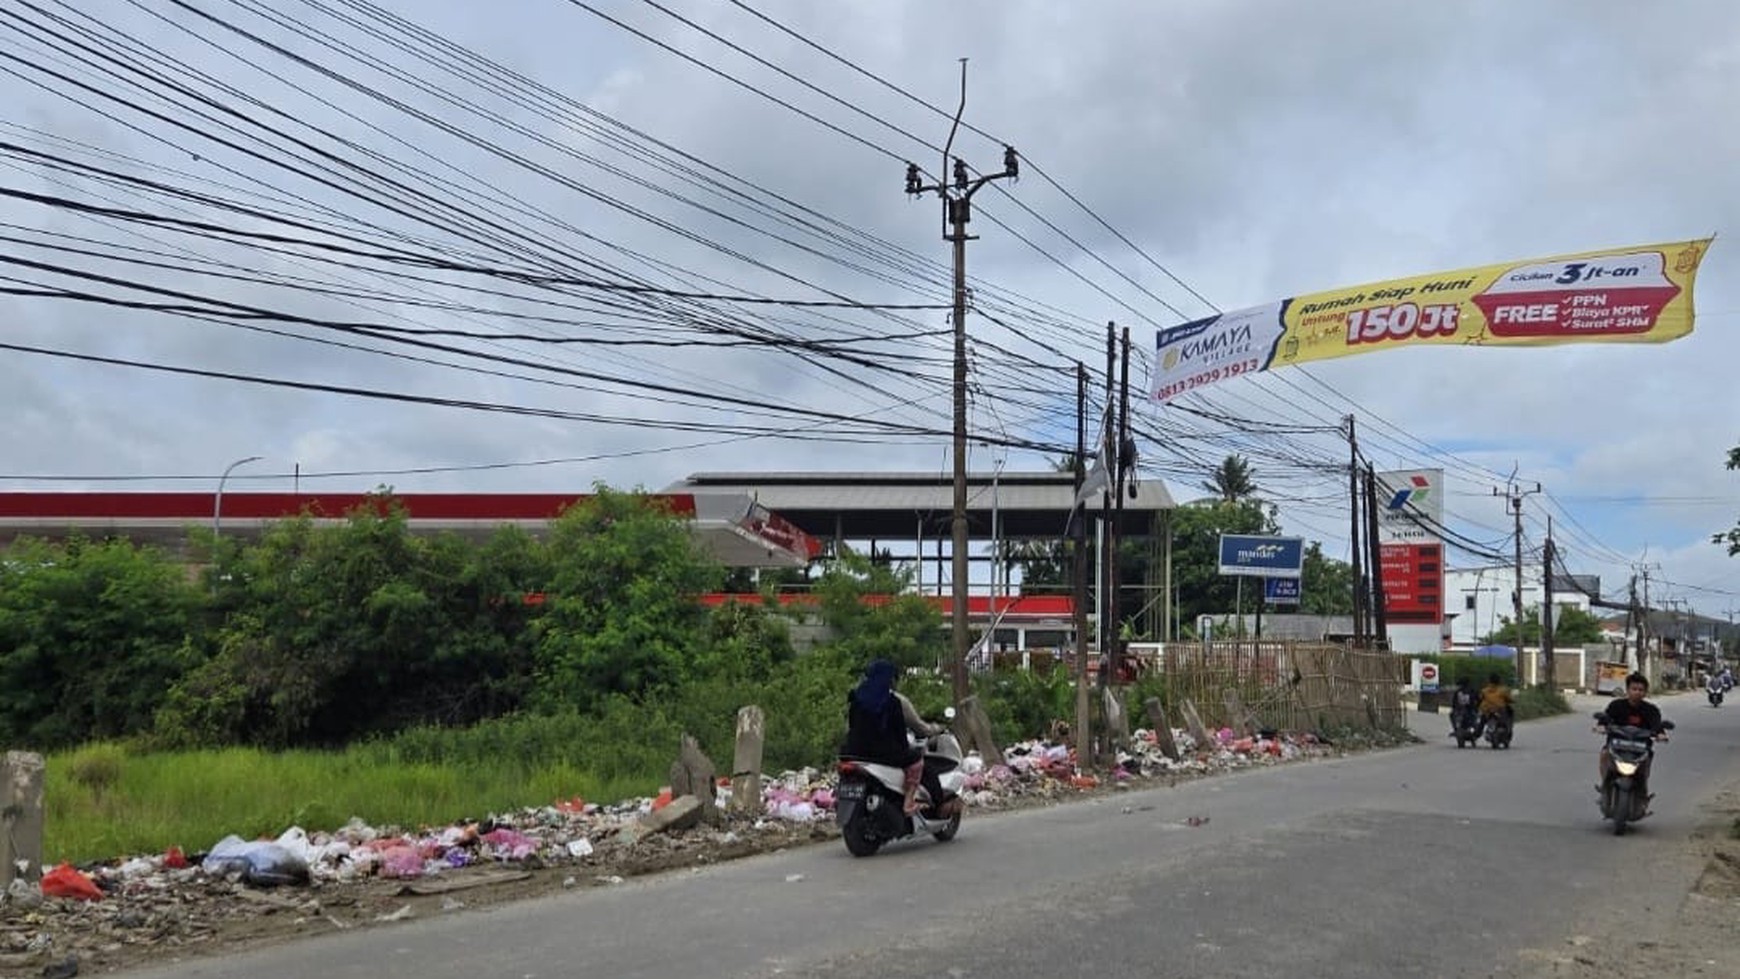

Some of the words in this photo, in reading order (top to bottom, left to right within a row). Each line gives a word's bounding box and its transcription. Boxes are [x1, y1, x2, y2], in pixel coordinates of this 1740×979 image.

[1555, 263, 1588, 284] 3
[1299, 293, 1366, 315] Rumah
[1368, 287, 1415, 301] Siap
[1420, 275, 1477, 294] Huni
[1572, 294, 1608, 306] PPN
[1494, 304, 1559, 324] FREE
[1616, 317, 1649, 327] SHM
[1180, 323, 1251, 362] KAMAYA
[1188, 368, 1220, 389] 2929
[1223, 358, 1258, 379] 1913
